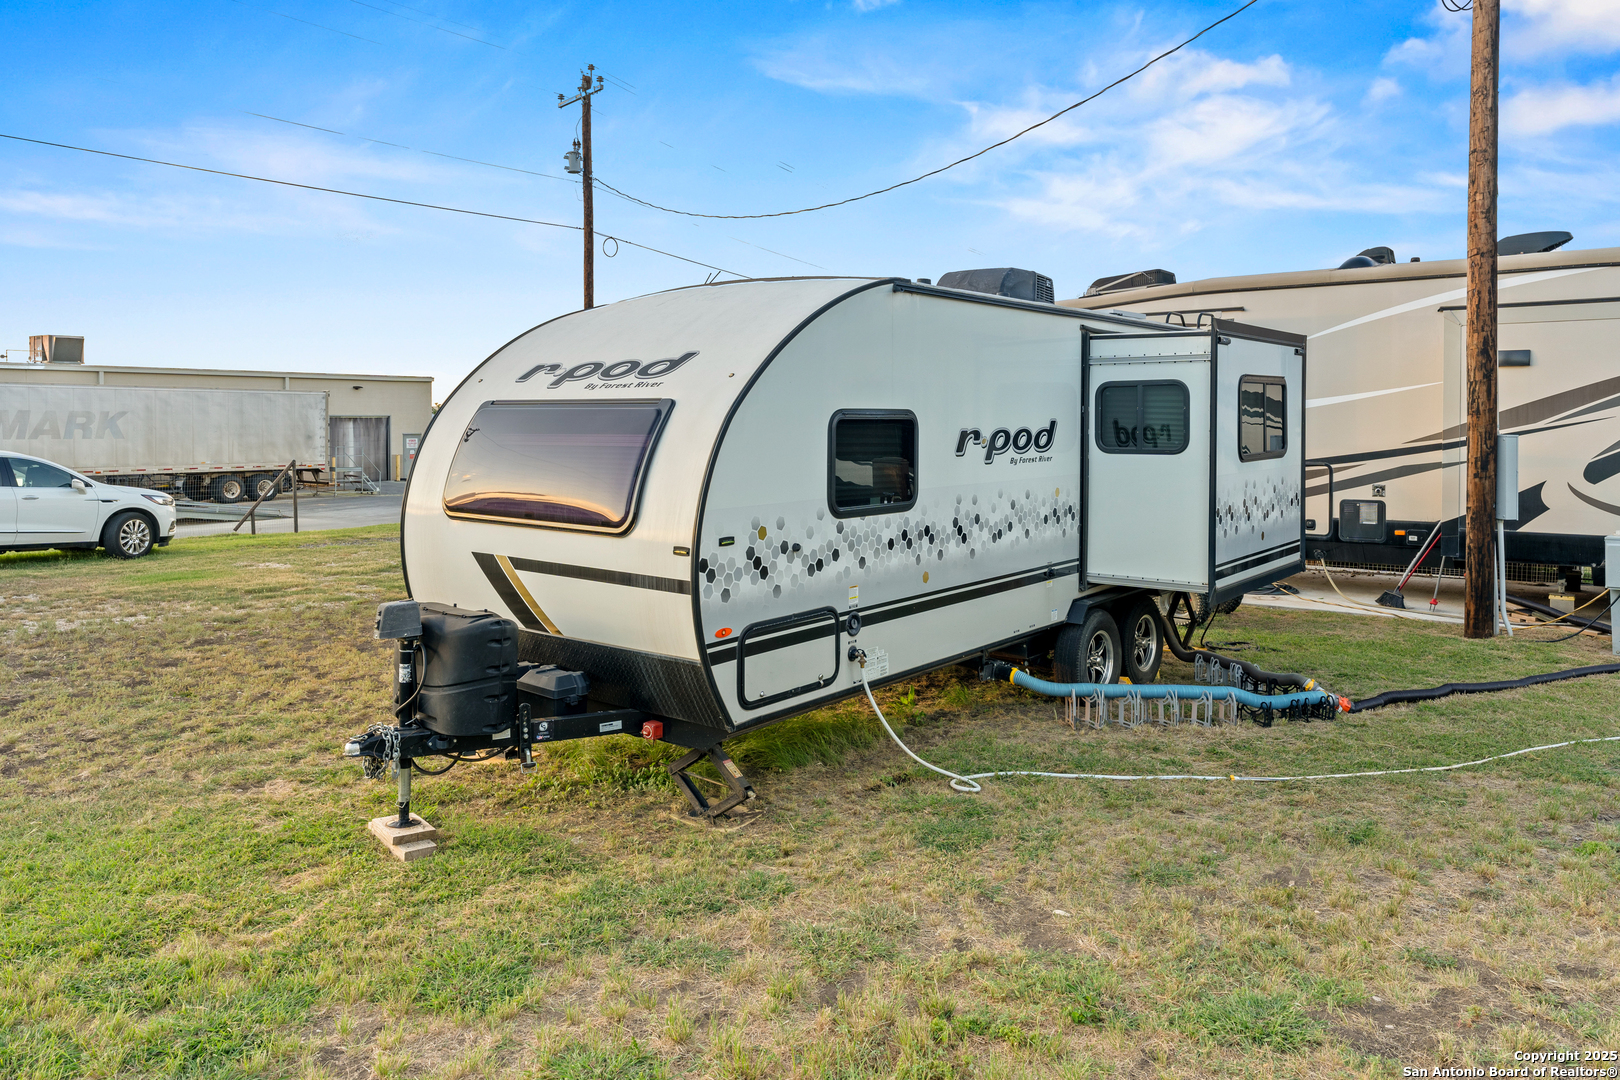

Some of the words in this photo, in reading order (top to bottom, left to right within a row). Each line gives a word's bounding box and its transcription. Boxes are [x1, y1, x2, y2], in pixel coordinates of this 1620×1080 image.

[584, 382, 596, 390] By
[599, 381, 633, 389] Forest
[1010, 457, 1018, 466] By
[1019, 456, 1037, 464] Forest
[1038, 455, 1053, 463] River
